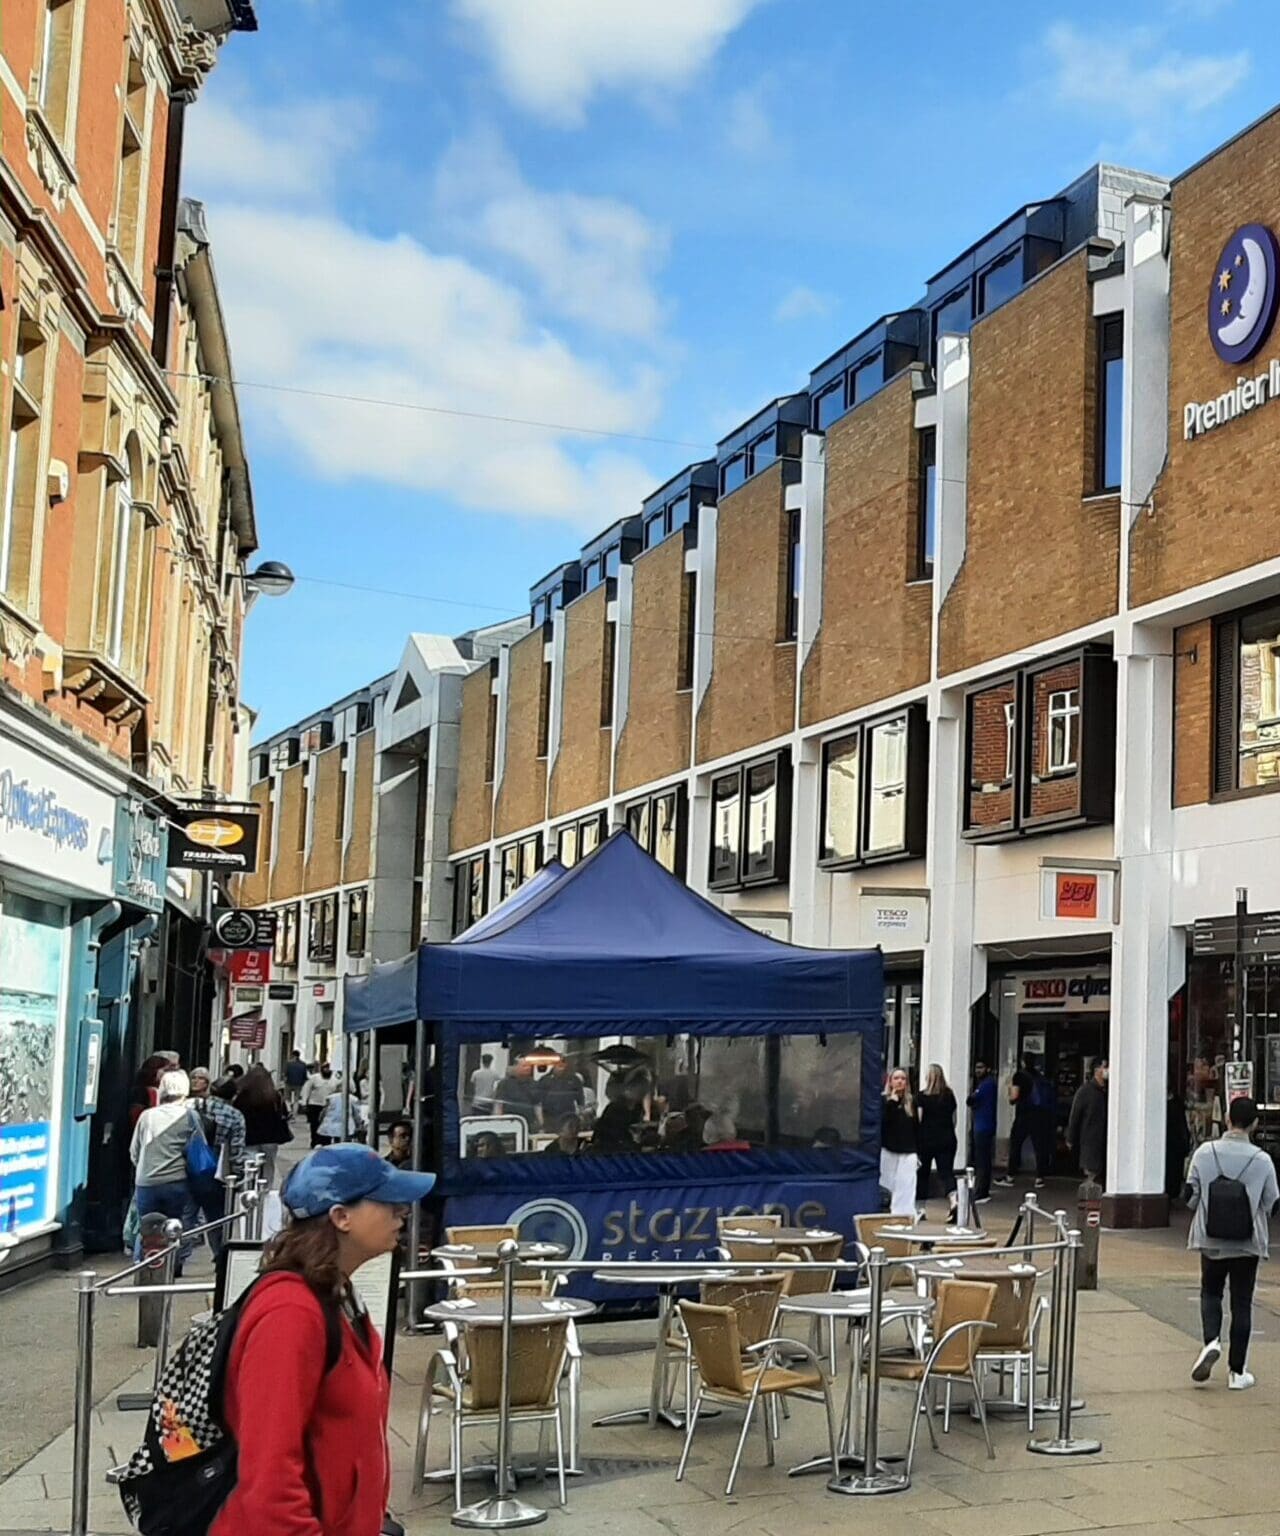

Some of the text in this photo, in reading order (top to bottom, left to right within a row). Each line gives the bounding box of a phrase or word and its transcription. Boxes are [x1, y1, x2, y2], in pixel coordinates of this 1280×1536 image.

[1184, 373, 1269, 440] Premier
[877, 909, 908, 917] TESCO
[1023, 979, 1067, 999] TESCO
